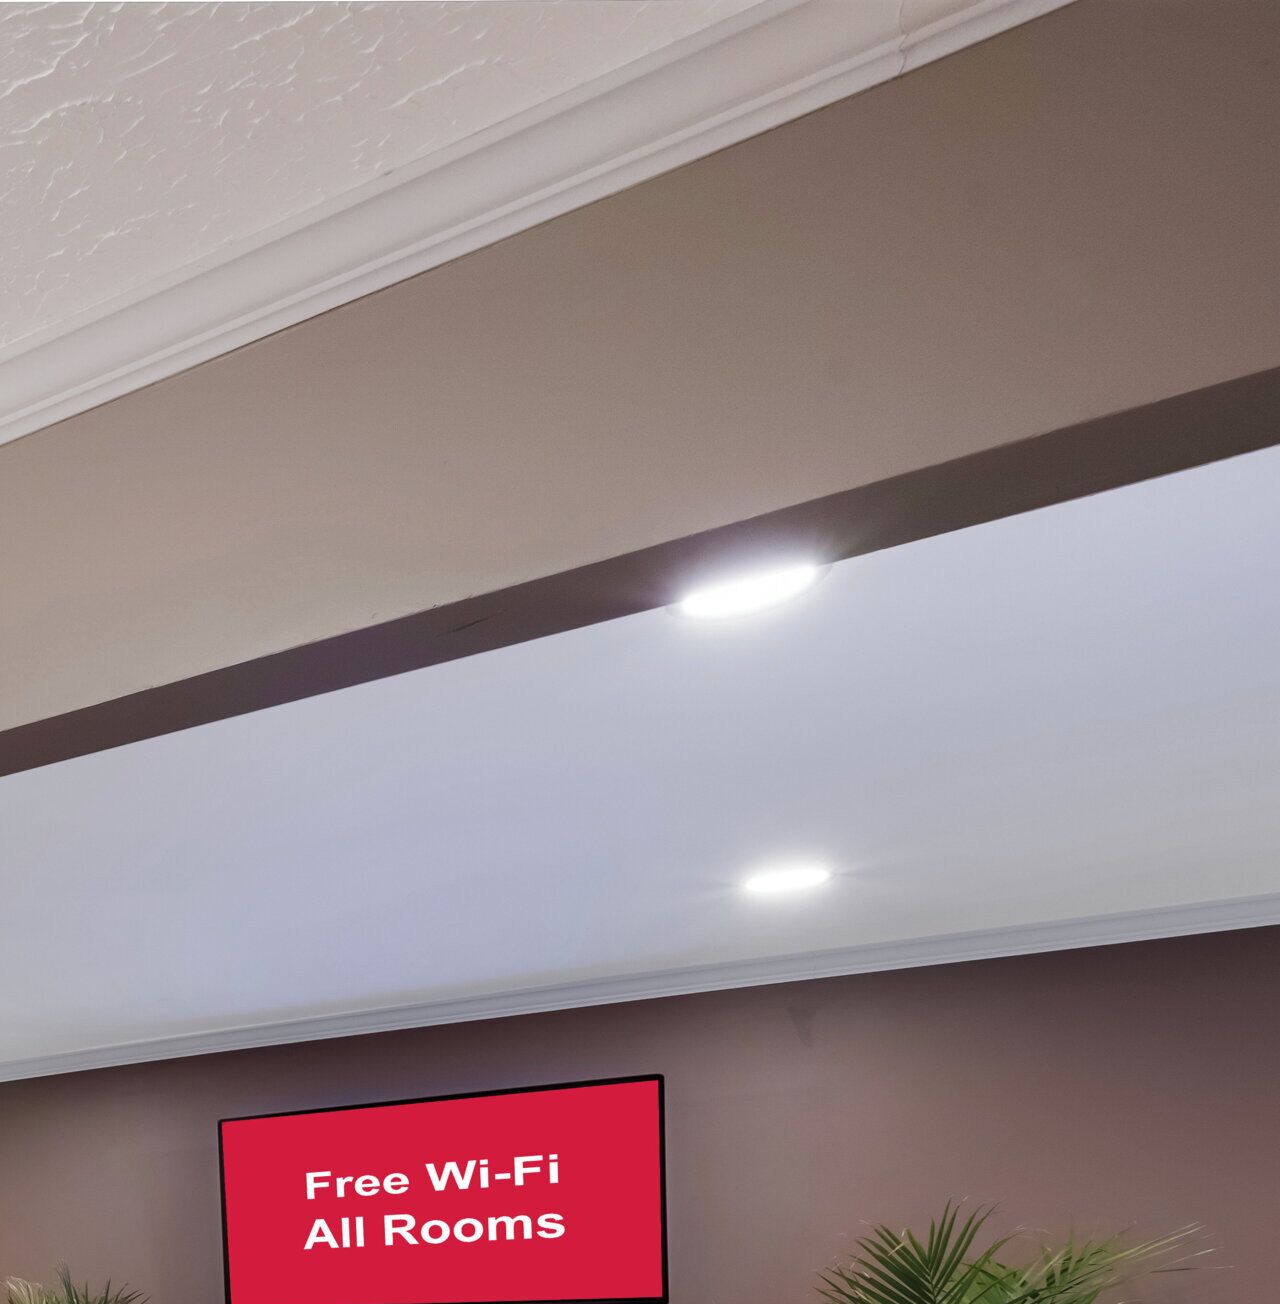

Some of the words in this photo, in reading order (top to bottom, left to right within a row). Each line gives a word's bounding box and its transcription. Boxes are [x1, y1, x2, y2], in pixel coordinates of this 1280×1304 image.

[305, 1170, 410, 1200] Free
[425, 1153, 560, 1191] Wi-Fi
[303, 1216, 364, 1250] All
[383, 1212, 566, 1247] Rooms
